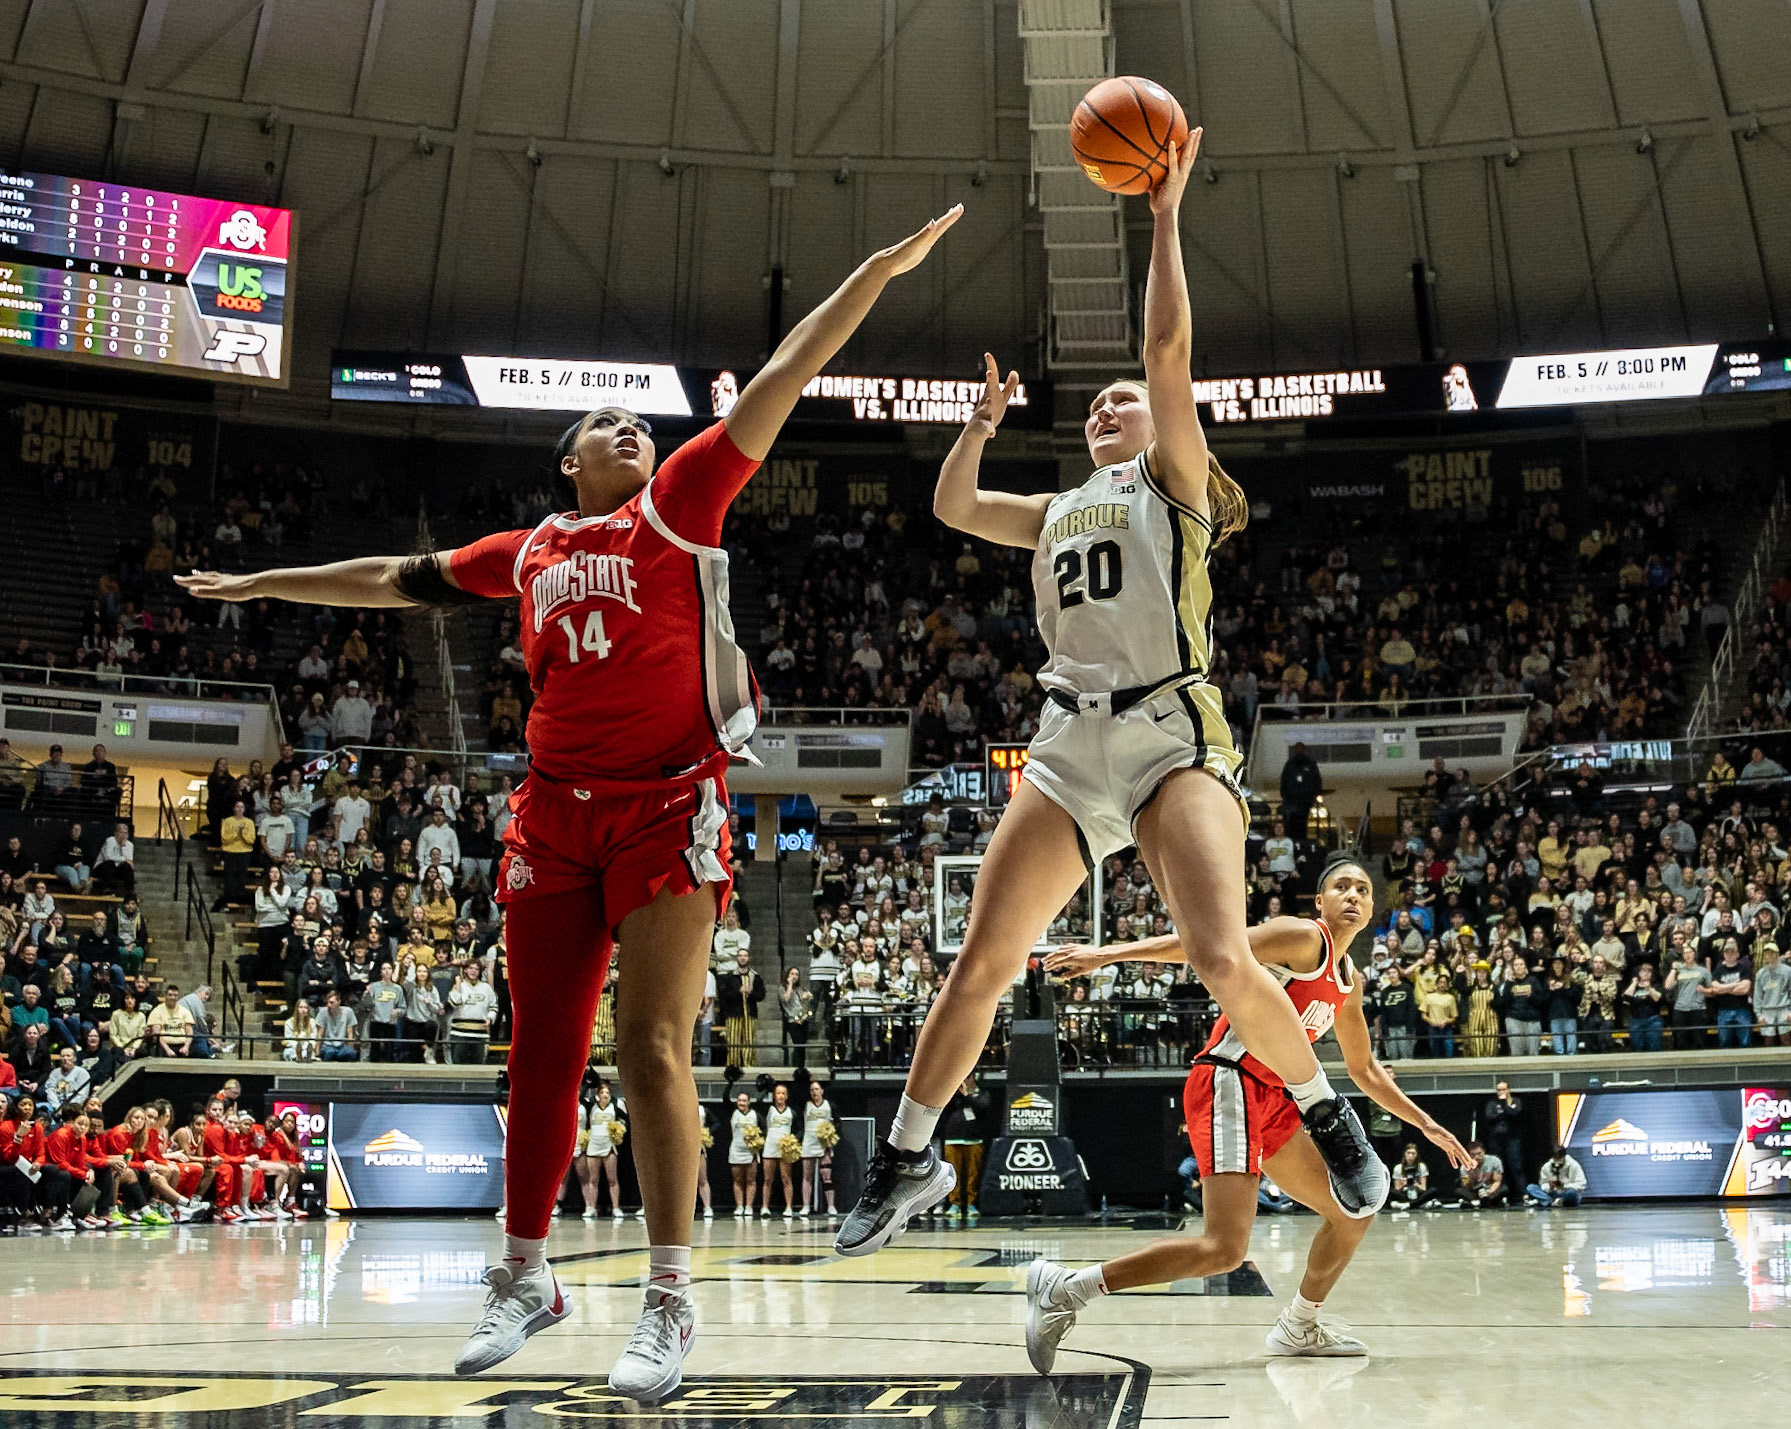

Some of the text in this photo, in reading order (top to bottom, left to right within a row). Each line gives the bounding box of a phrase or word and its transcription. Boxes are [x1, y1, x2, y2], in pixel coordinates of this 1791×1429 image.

[0, 175, 178, 211] eene 3 1 2 0 1
[94, 216, 103, 228] 0
[119, 220, 128, 232] 0
[145, 224, 152, 235] 1
[168, 227, 176, 239] 2
[122, 206, 128, 218] 1
[146, 210, 153, 221] 1
[168, 213, 177, 225] 2
[68, 227, 76, 239] 2
[95, 231, 101, 242] 1
[117, 235, 126, 246] 2
[142, 238, 151, 250] 0
[166, 242, 175, 253] 0
[68, 242, 75, 253] 1
[94, 246, 100, 257] 1
[118, 249, 125, 260] 1
[141, 252, 150, 264] 0
[165, 256, 174, 268] 0
[66, 259, 74, 269] P
[90, 262, 99, 273] R
[114, 266, 123, 277] A
[165, 273, 172, 282] F
[64, 276, 72, 286] 4
[114, 282, 122, 293] 2
[138, 286, 147, 297] 0
[165, 289, 171, 300] 1
[63, 290, 71, 301] 3
[88, 293, 96, 304] 0
[112, 297, 121, 308] 0
[137, 300, 146, 311] 0
[162, 304, 170, 315] 0
[216, 293, 262, 312] FOODS
[61, 305, 70, 316] 4
[111, 311, 120, 322] 0
[136, 315, 144, 326] 0
[161, 318, 169, 329] 2
[85, 323, 93, 334] 4
[110, 326, 119, 337] 2
[135, 329, 144, 340] 0
[160, 333, 168, 344] 0
[59, 334, 67, 345] 3
[84, 337, 93, 349] 0
[109, 341, 118, 352] 0
[134, 344, 142, 355] 0
[159, 347, 167, 358] 0
[499, 367, 534, 385] FEB.
[540, 370, 551, 385] 5
[581, 372, 618, 388] 8:00
[624, 374, 650, 389] PM
[1537, 364, 1571, 380] FEB.
[1578, 362, 1588, 378] 5
[1616, 358, 1654, 375] 8:00
[1660, 356, 1686, 373] PM
[1258, 370, 1386, 398] BASKETBALL
[854, 398, 976, 423] VS. ILLINOIS
[1213, 395, 1333, 422] VS. ILLINOIS
[23, 402, 120, 441] PAINT
[20, 432, 117, 471] CREW
[146, 440, 193, 468] 104
[751, 459, 819, 487] AINT
[1408, 450, 1493, 481] PAINT
[1309, 484, 1384, 497] WABASH
[1521, 466, 1563, 493] 106
[848, 482, 888, 505] 105
[1408, 479, 1493, 510] CREW
[1046, 503, 1129, 554] PURDUE
[1054, 540, 1124, 610] 20
[557, 610, 612, 663] 14
[296, 1114, 325, 1132] 50
[1010, 1109, 1053, 1118] PURDUE
[1010, 1118, 1053, 1126] FEDERAL
[302, 1150, 323, 1160] 1.5
[364, 1153, 423, 1166] PURDUE
[1592, 1142, 1648, 1156] PURDUE
[1651, 1153, 1712, 1162] CREDIT UNION
[425, 1166, 457, 1174] CREDIT
